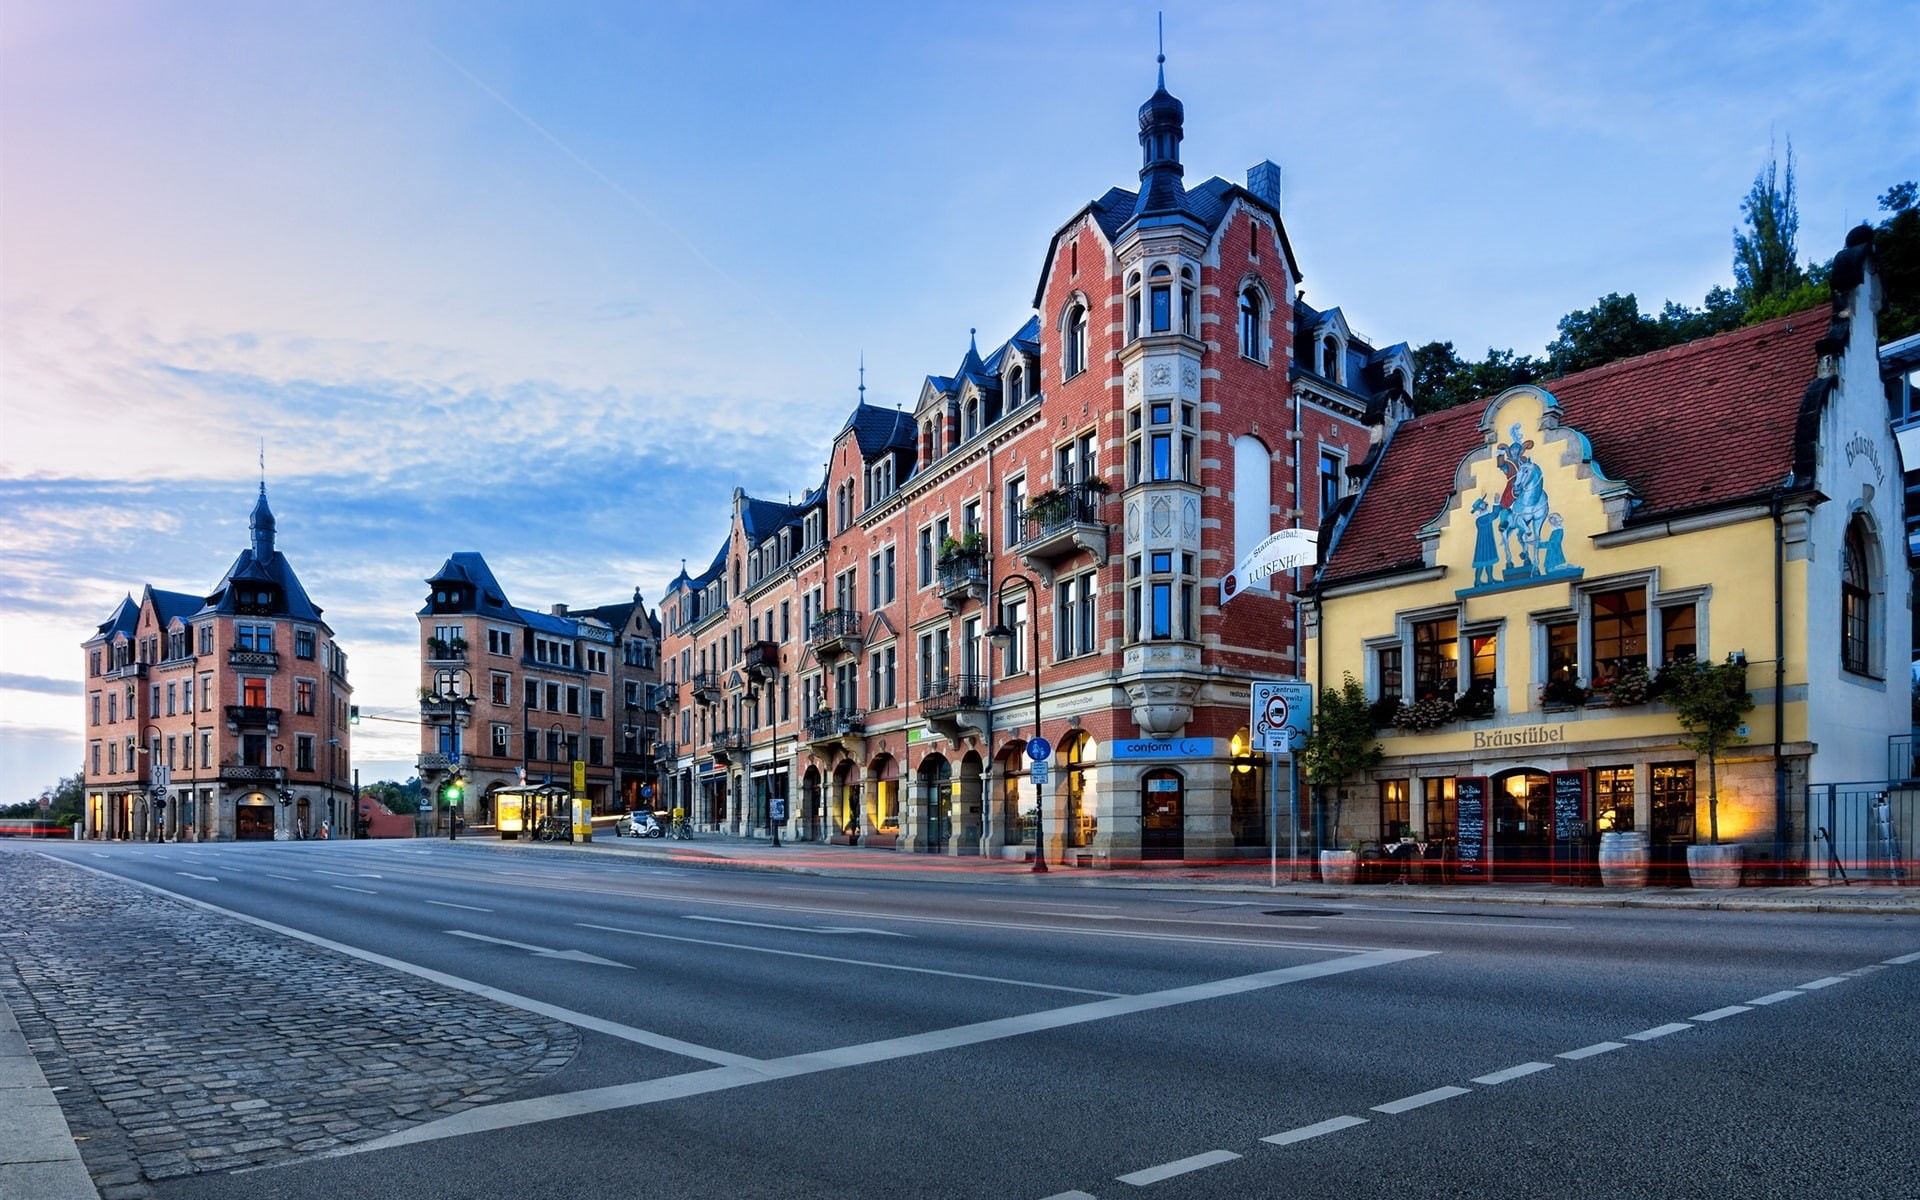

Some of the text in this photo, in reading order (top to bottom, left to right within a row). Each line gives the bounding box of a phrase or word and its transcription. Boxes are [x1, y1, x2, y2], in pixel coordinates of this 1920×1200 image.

[1249, 552, 1309, 585] LUISENHOF
[1127, 742, 1172, 752] conform
[1473, 725, 1564, 748] Bräustübel
